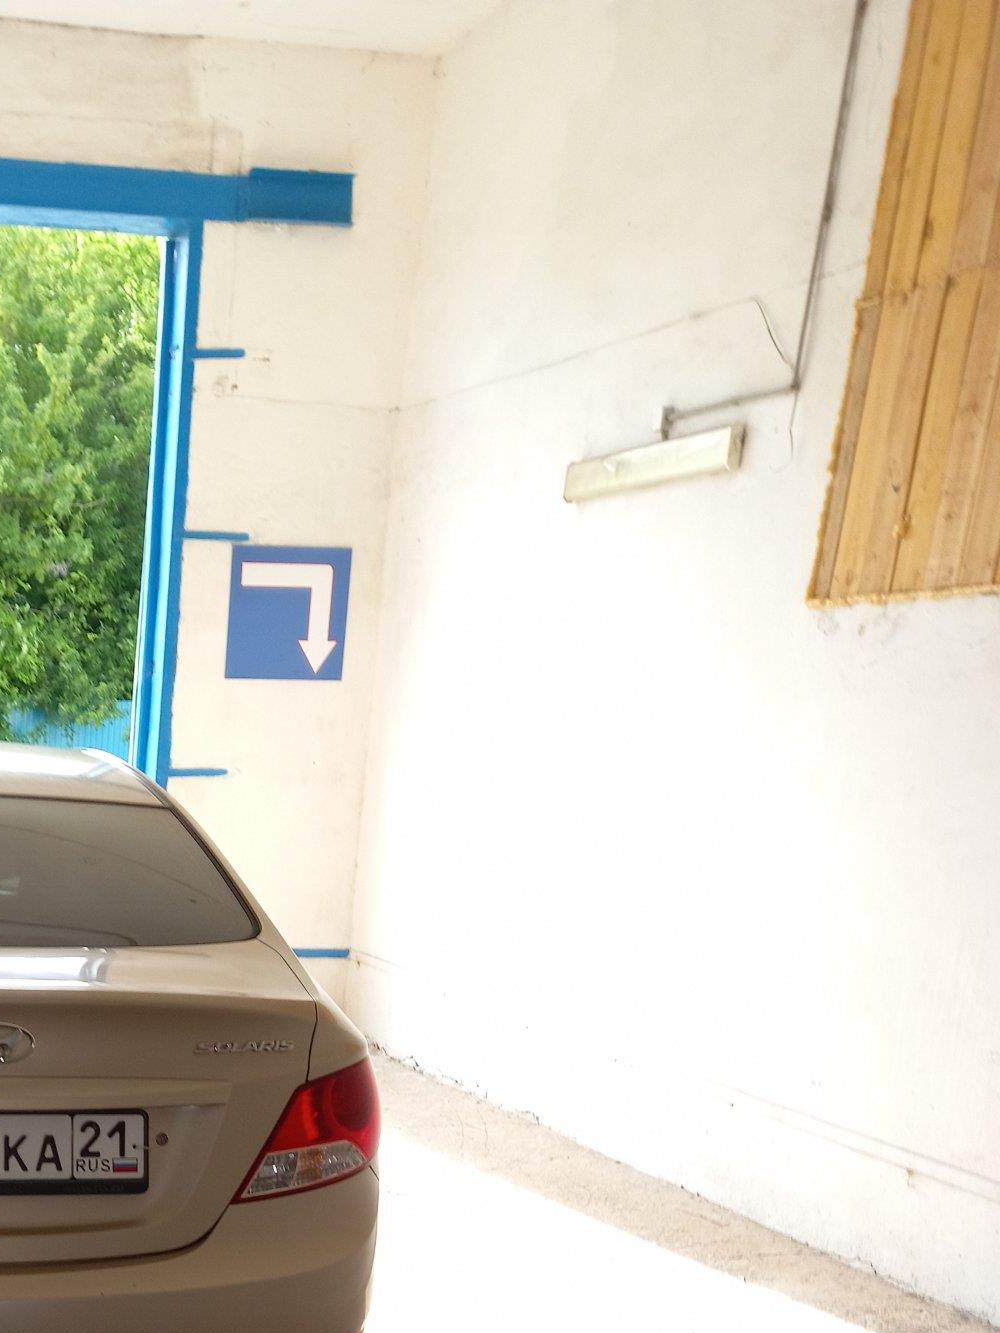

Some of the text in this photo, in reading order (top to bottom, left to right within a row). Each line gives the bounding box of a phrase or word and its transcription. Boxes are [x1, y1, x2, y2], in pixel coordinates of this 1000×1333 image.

[193, 1039, 296, 1056] SOLARIS
[79, 1119, 127, 1160] 21
[75, 1158, 111, 1173] RUS
